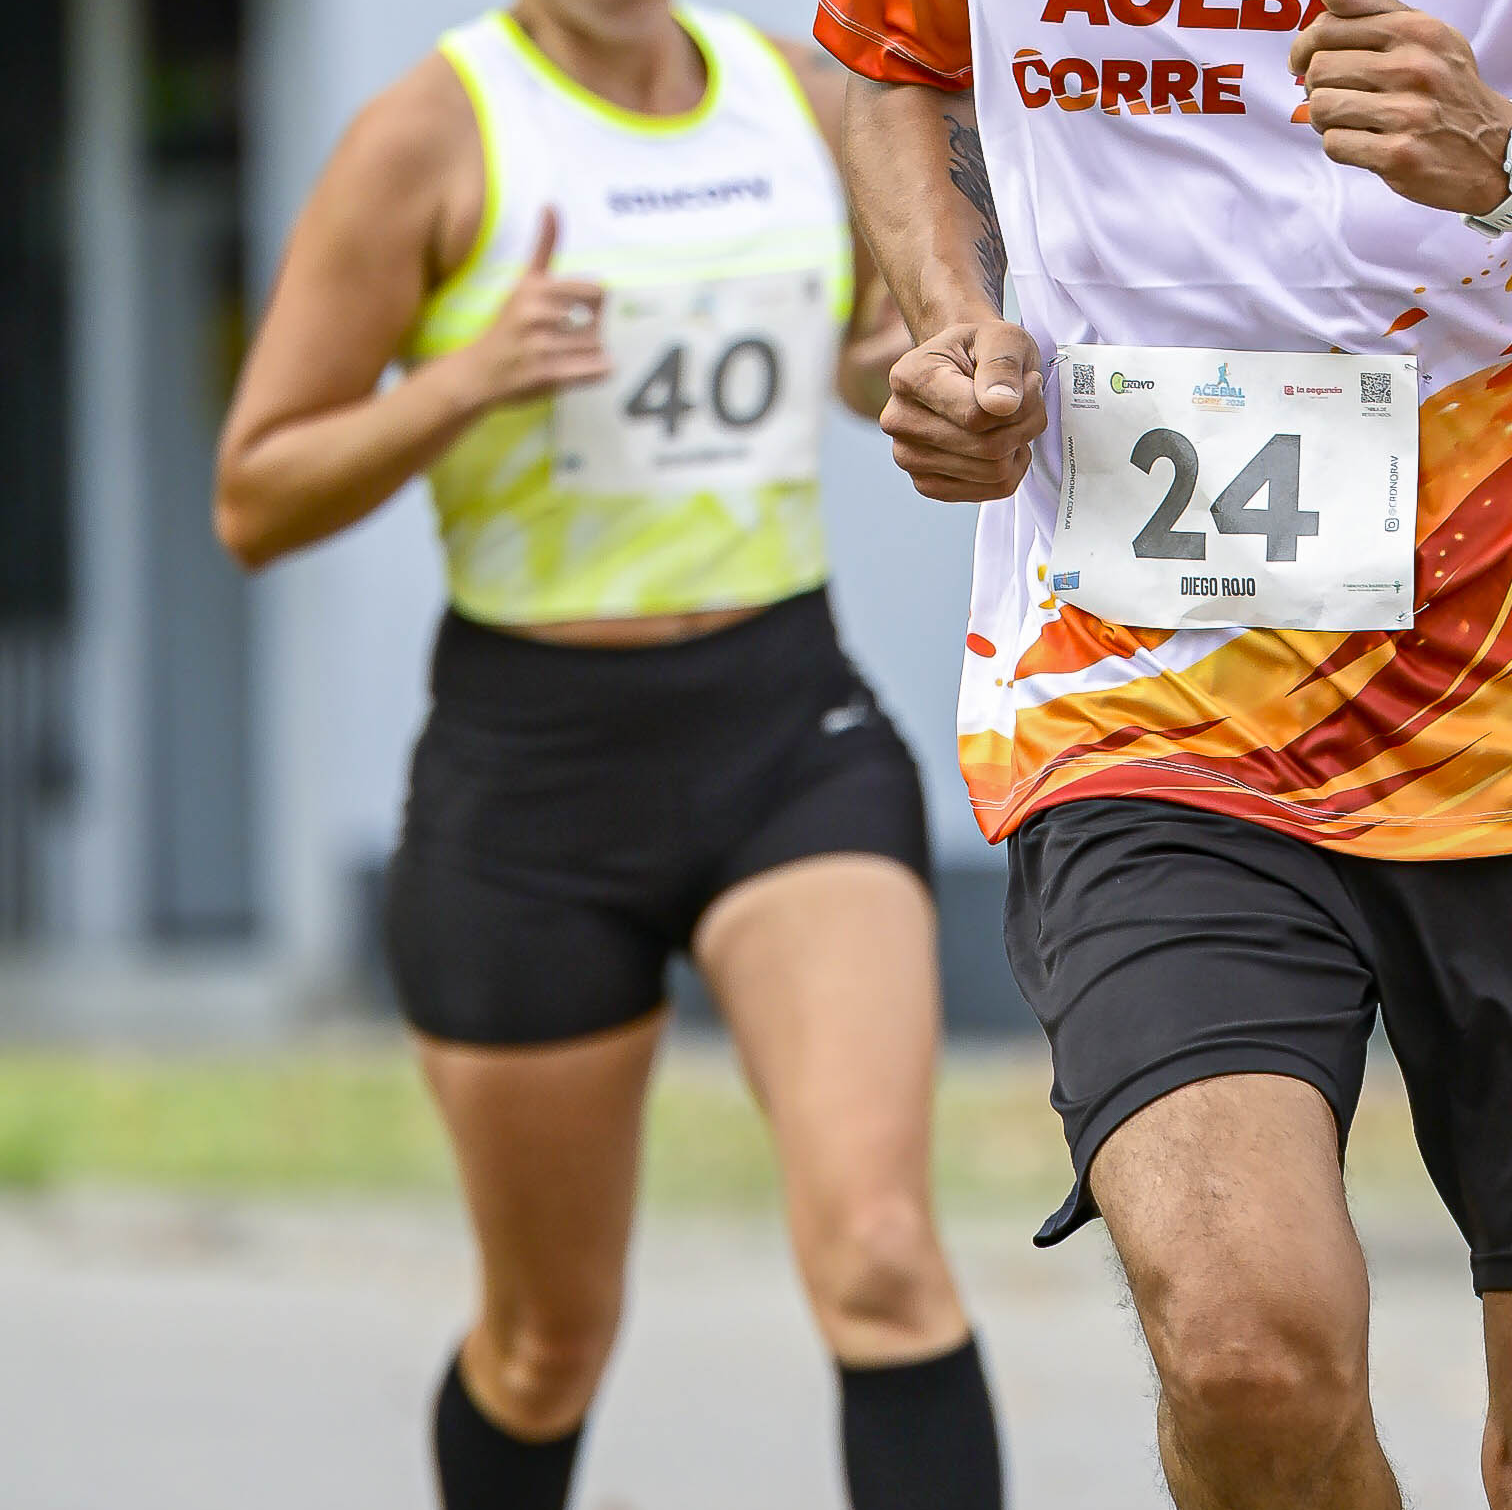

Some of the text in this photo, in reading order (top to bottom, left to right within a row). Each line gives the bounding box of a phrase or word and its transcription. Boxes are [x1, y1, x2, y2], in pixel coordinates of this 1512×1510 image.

[1012, 49, 1247, 116] CORRE
[622, 337, 782, 439] 40
[1130, 427, 1320, 563] 24
[1180, 576, 1256, 596] DIEGO ROJO
